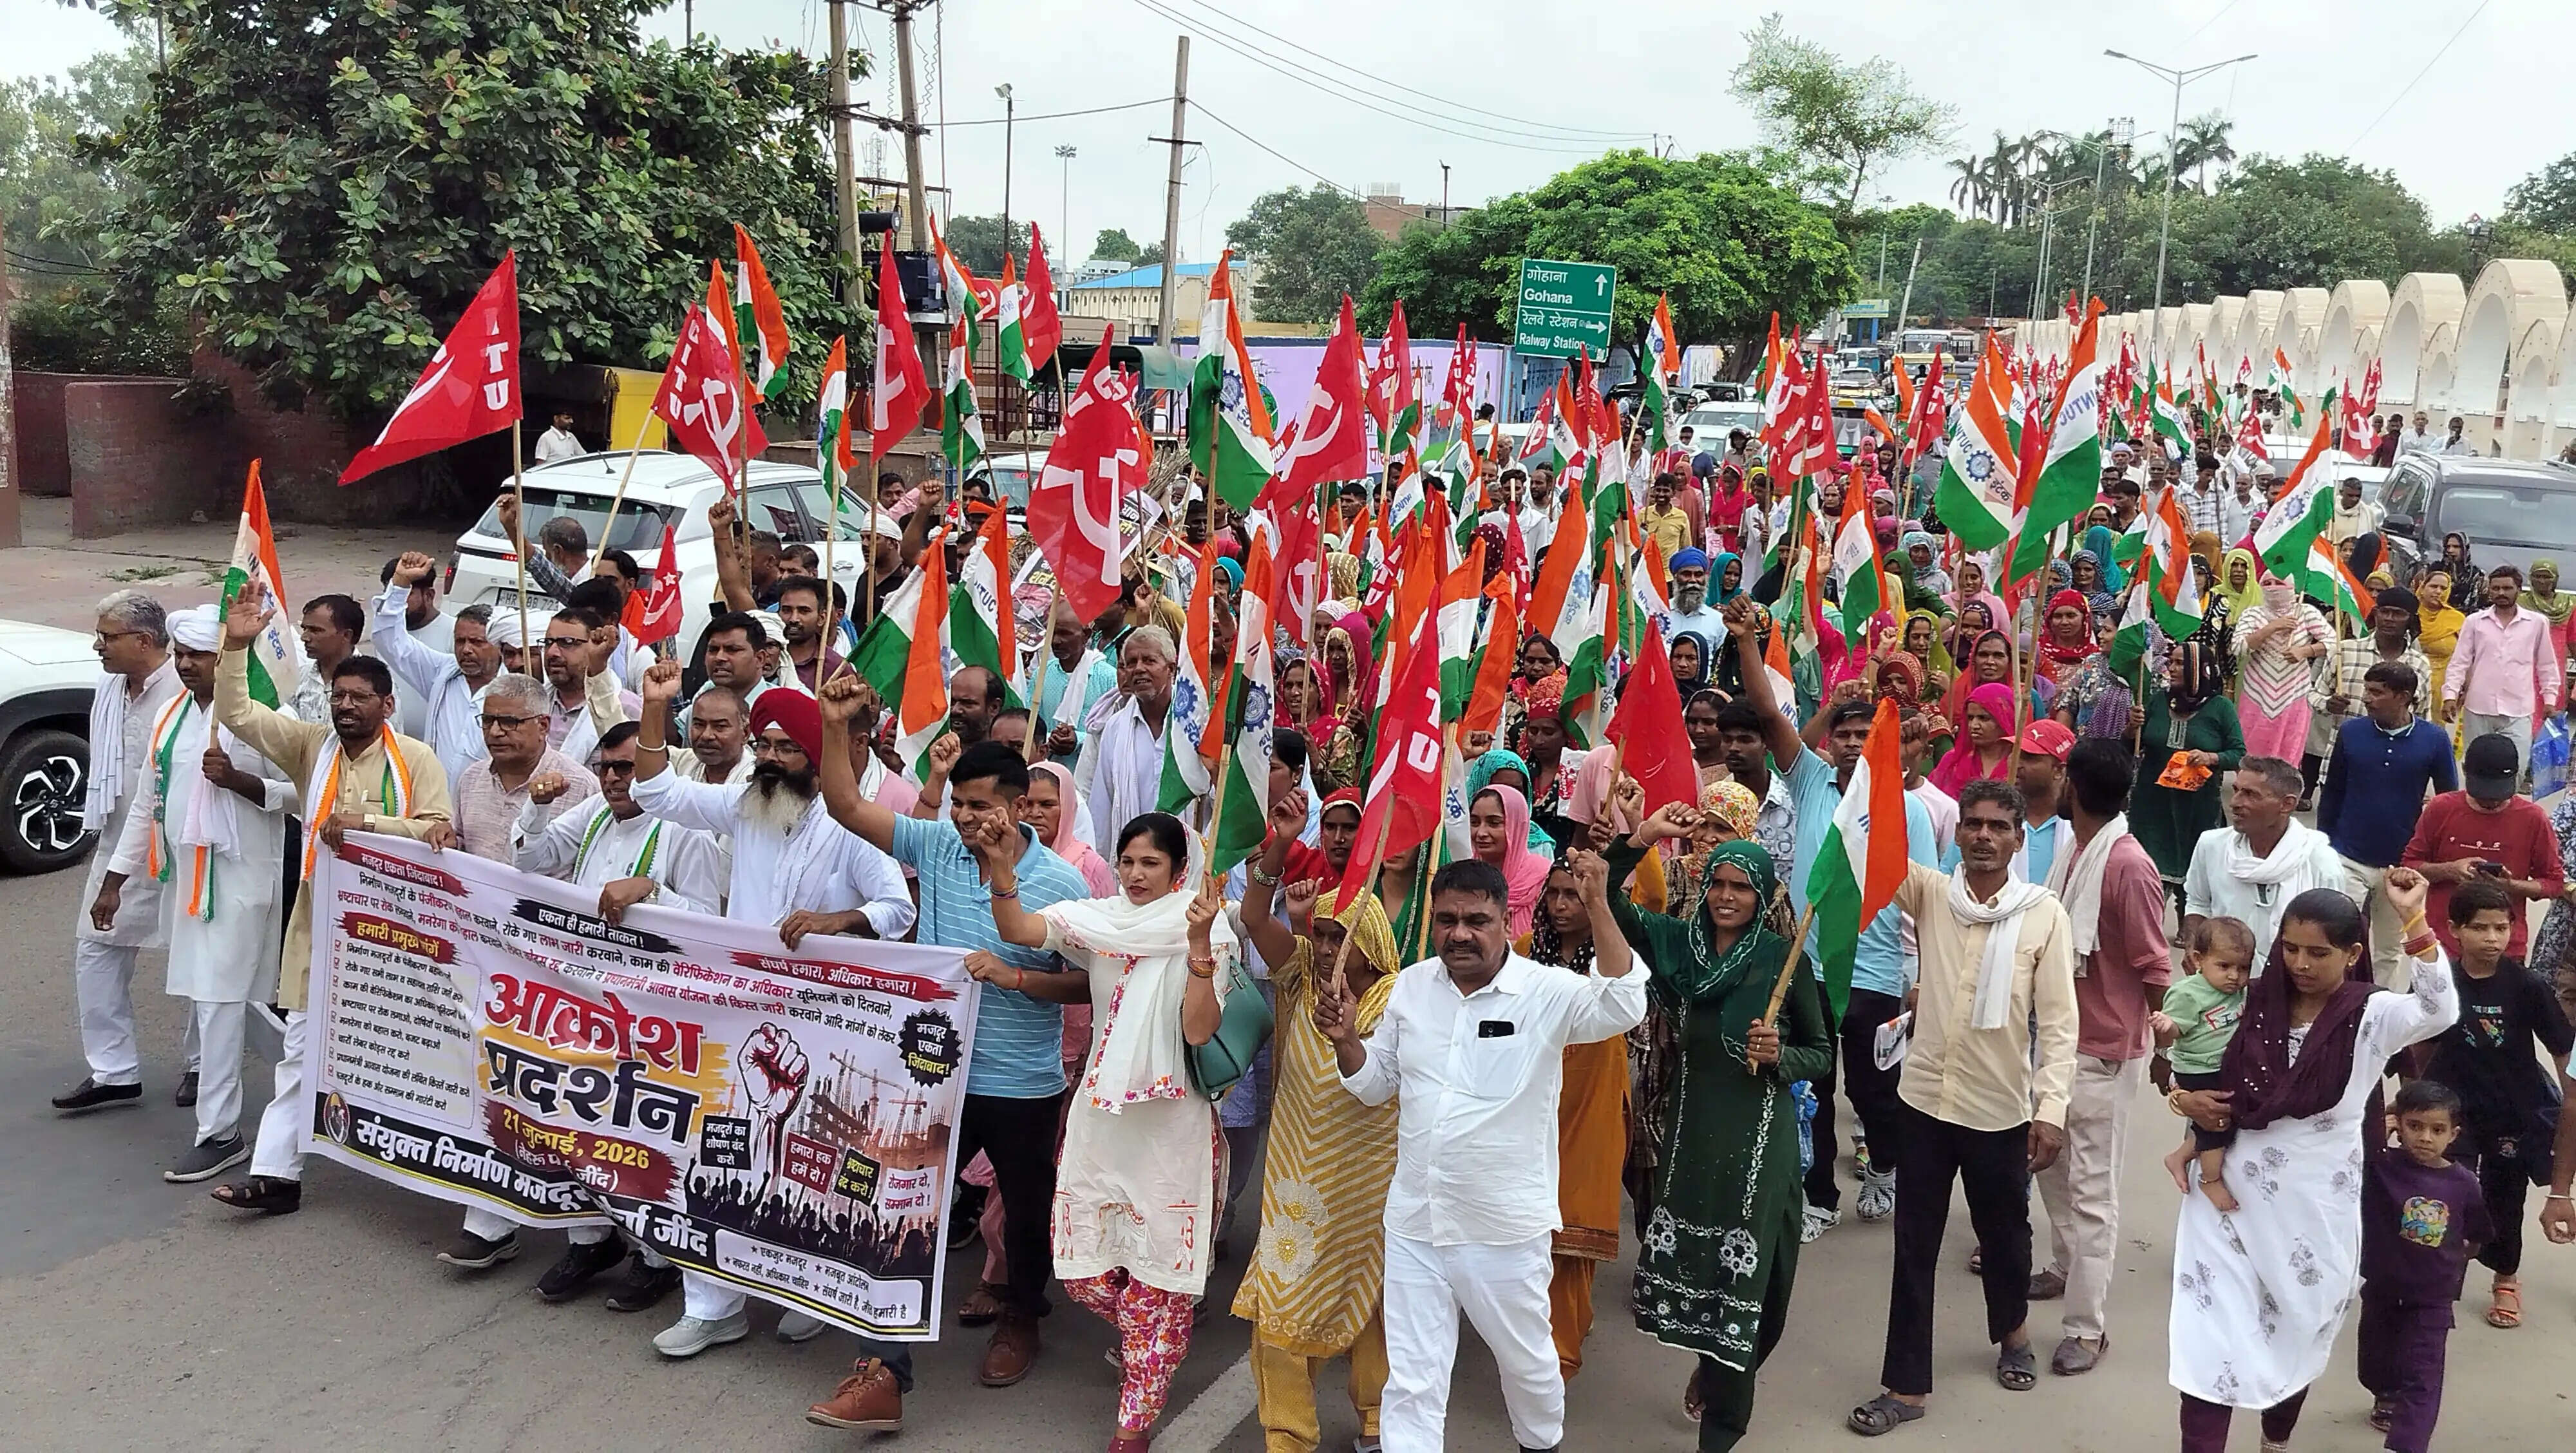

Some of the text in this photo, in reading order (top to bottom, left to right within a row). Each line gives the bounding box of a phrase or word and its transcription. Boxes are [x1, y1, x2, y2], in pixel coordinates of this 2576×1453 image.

[1527, 265, 1567, 283] गोहाना
[1524, 288, 1573, 304] Gohana
[1522, 310, 1545, 326] रेलवे
[1549, 312, 1578, 328] स्टेशन
[1519, 333, 1550, 350] Ralway
[2011, 397, 2025, 414] NTUC
[974, 582, 996, 612] TUC
[1446, 786, 1466, 819] ंटक
[361, 853, 405, 877] मजदूर एकता
[539, 908, 606, 938] एकता ही हमारी
[357, 920, 419, 951] हमारी प्रमुख
[360, 872, 383, 891] निर्माण
[408, 889, 416, 902] के
[503, 921, 520, 938] रोके
[523, 929, 537, 944] गए
[539, 933, 560, 950] लाभ
[562, 940, 583, 956] जारी
[587, 946, 626, 966] करवाने,
[630, 954, 653, 970] काम
[656, 958, 670, 974] की
[673, 962, 733, 987] वेरिफिकेशन
[733, 976, 749, 991] का
[750, 979, 793, 999] अधिकार
[797, 988, 838, 1005] यूनियनों
[840, 993, 855, 1007] को
[857, 998, 893, 1020] दिलवाने,
[346, 943, 369, 957] निर्माण
[370, 949, 392, 964] मजदूरों
[394, 954, 401, 964] के
[345, 961, 358, 972] रोके
[370, 898, 379, 909] पर
[381, 899, 393, 913] रोक
[418, 913, 448, 931] मनरेगा
[563, 962, 596, 980] करवाने
[595, 969, 604, 981] व
[602, 972, 648, 992] प्रधानमंत्री
[646, 981, 677, 999] आवास
[679, 985, 710, 1004] योजना
[712, 993, 728, 1007] की
[729, 995, 758, 1011] किस्त
[759, 1002, 786, 1016] जारी
[788, 1007, 822, 1024] करवाने
[824, 1014, 842, 1028] आदि
[845, 1019, 866, 1035] मांगों
[867, 1023, 877, 1038] को
[877, 1029, 896, 1044] लेकर
[791, 961, 825, 981] हमारा,
[828, 967, 873, 988] अधिकार
[343, 980, 358, 991] काम
[360, 982, 368, 992] की
[368, 1005, 376, 1014] पर
[485, 973, 704, 1075] आक्रोश
[917, 1023, 947, 1042] मजदूर
[918, 1040, 943, 1057] एकता
[908, 1052, 949, 1075] जिंदाबाद!
[484, 1038, 701, 1145] प्रदर्शन
[504, 1108, 520, 1135] 21
[594, 1141, 650, 1170] 2026
[706, 1121, 746, 1137] मजदूरों का
[706, 1138, 744, 1152] शोषण बंद
[790, 1141, 833, 1166] हमारा हक
[716, 1152, 735, 1166] करो
[791, 1160, 808, 1178] हमें
[357, 1114, 432, 1164] संयुक्त
[433, 1133, 512, 1190] निर्माण
[654, 1210, 707, 1258] जींद
[888, 1173, 917, 1190] रोजगार
[760, 1247, 846, 1286] एकजुट मजदूर मजबूत
[766, 1268, 790, 1284] अधिकार
[822, 1284, 837, 1300] संघर्ष
[838, 1291, 853, 1306] जारी
[873, 1304, 897, 1320] हमारी
[900, 1304, 907, 1318] है
